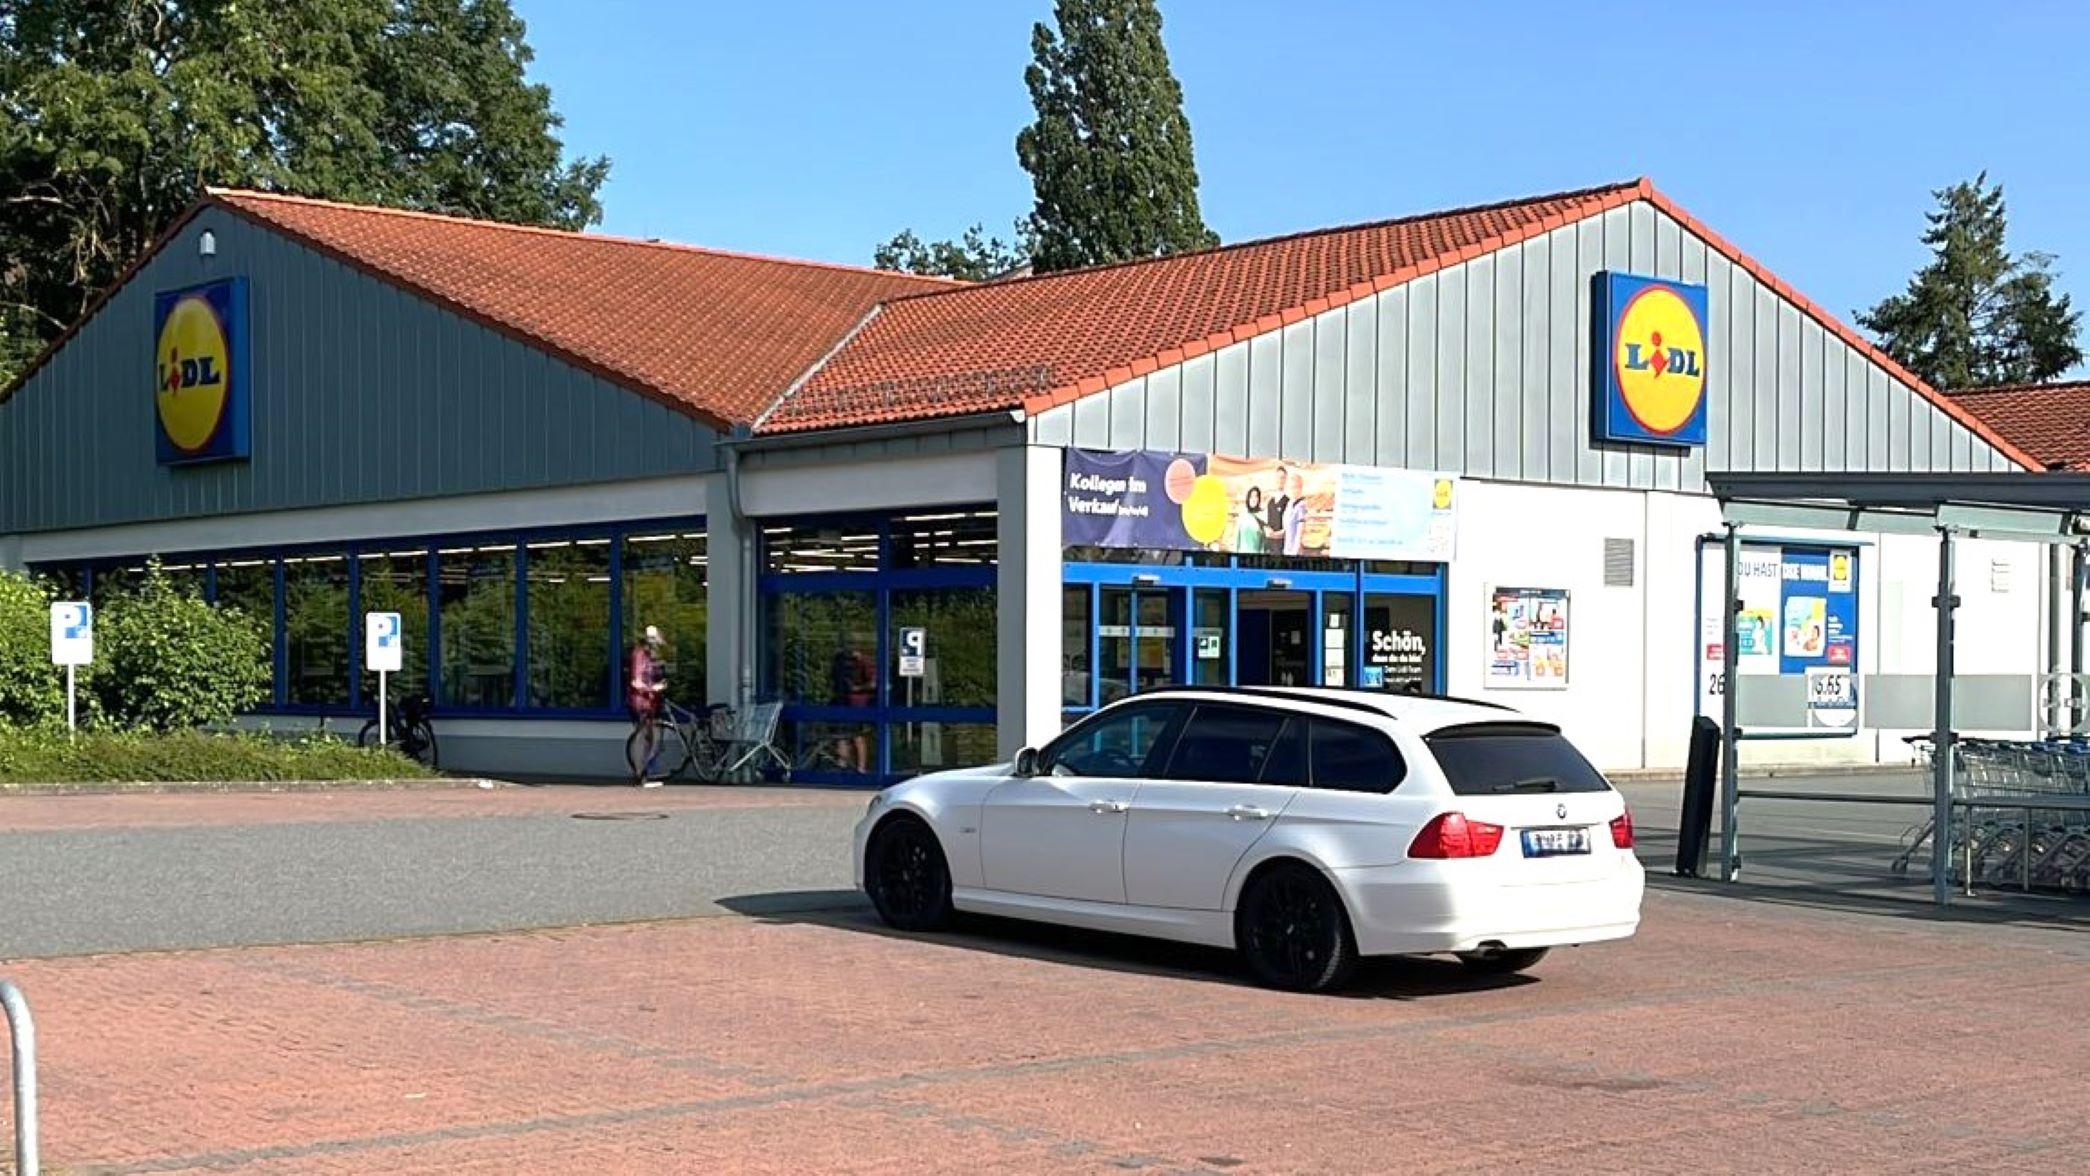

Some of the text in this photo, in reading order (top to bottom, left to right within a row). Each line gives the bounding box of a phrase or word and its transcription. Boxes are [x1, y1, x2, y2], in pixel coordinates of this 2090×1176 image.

[1067, 496, 1120, 514] Verkauf
[1753, 561, 1778, 577] HAST
[1372, 629, 1427, 655] Schön,
